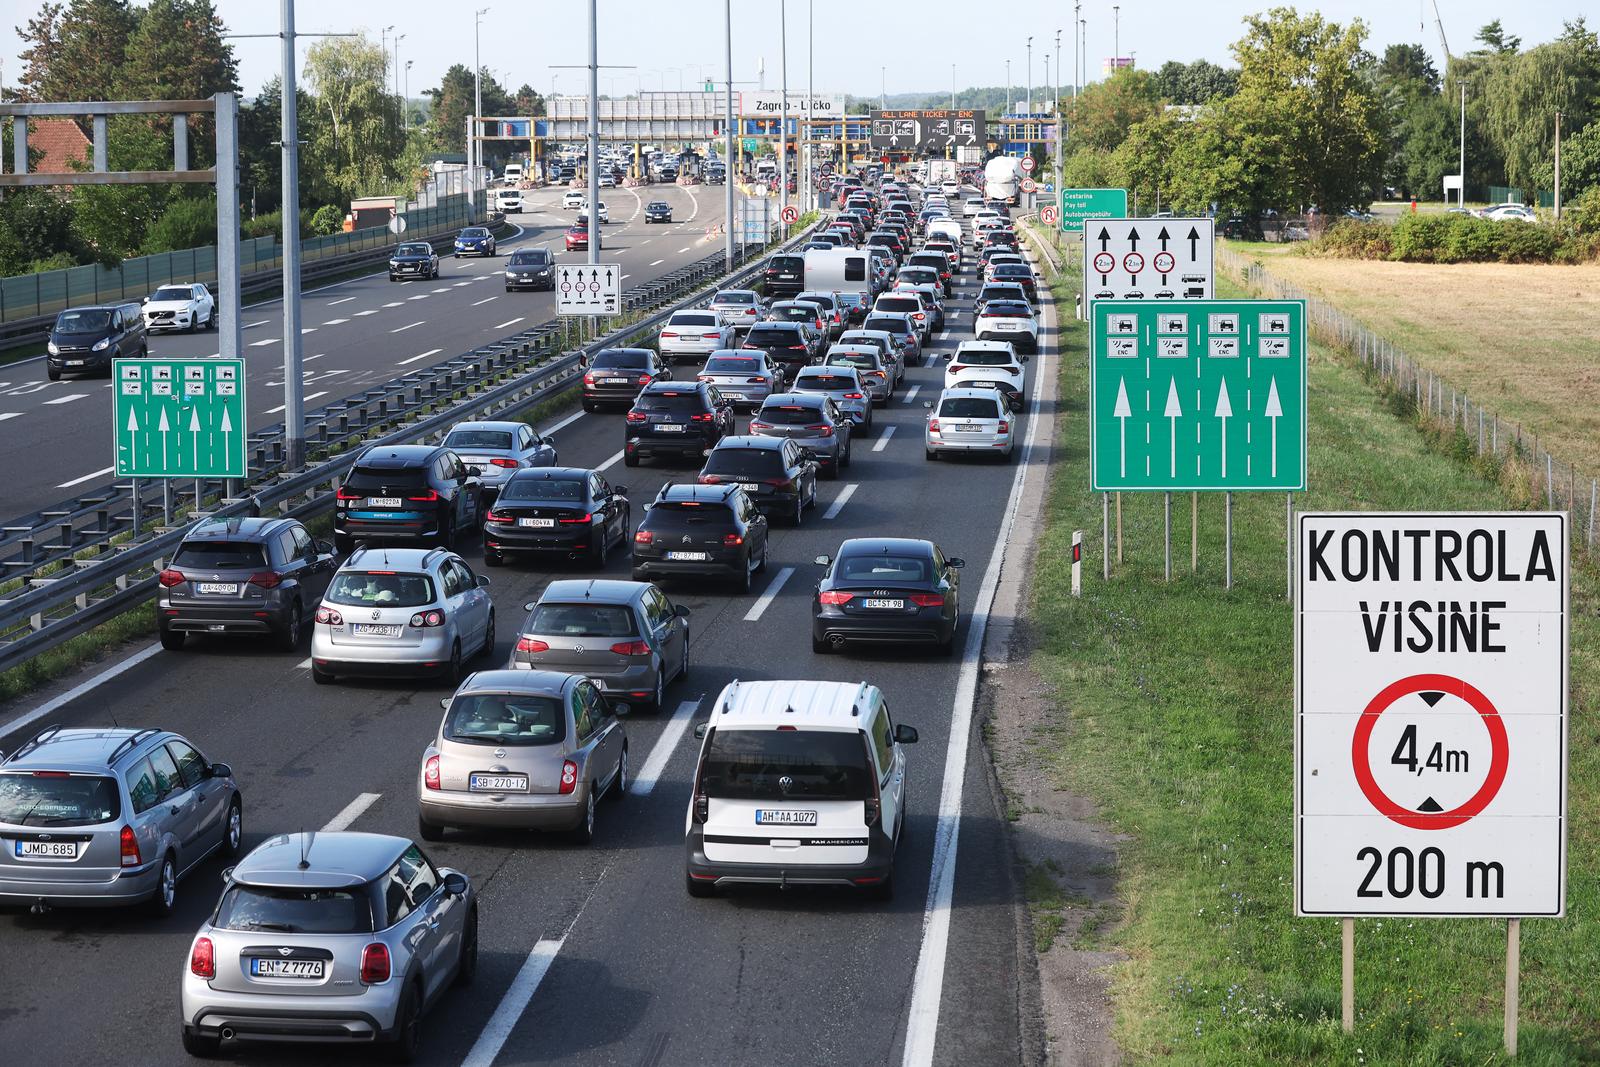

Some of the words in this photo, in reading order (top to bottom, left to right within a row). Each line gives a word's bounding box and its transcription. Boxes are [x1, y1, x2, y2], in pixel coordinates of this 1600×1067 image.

[801, 100, 831, 110] Lčko
[1309, 529, 1556, 582] KONTROLA
[360, 624, 368, 632] ZG
[1359, 600, 1506, 653] VISINE
[1391, 724, 1469, 776] 4,4m
[478, 778, 488, 787] SB
[762, 811, 774, 822] AH
[780, 812, 792, 822] AA
[793, 811, 815, 822] 1077
[24, 844, 73, 854] JMD-685
[1356, 846, 1445, 899] 200
[1466, 861, 1504, 898] m
[259, 960, 274, 972] EN
[282, 962, 290, 973] Z
[292, 962, 320, 974] 7776
